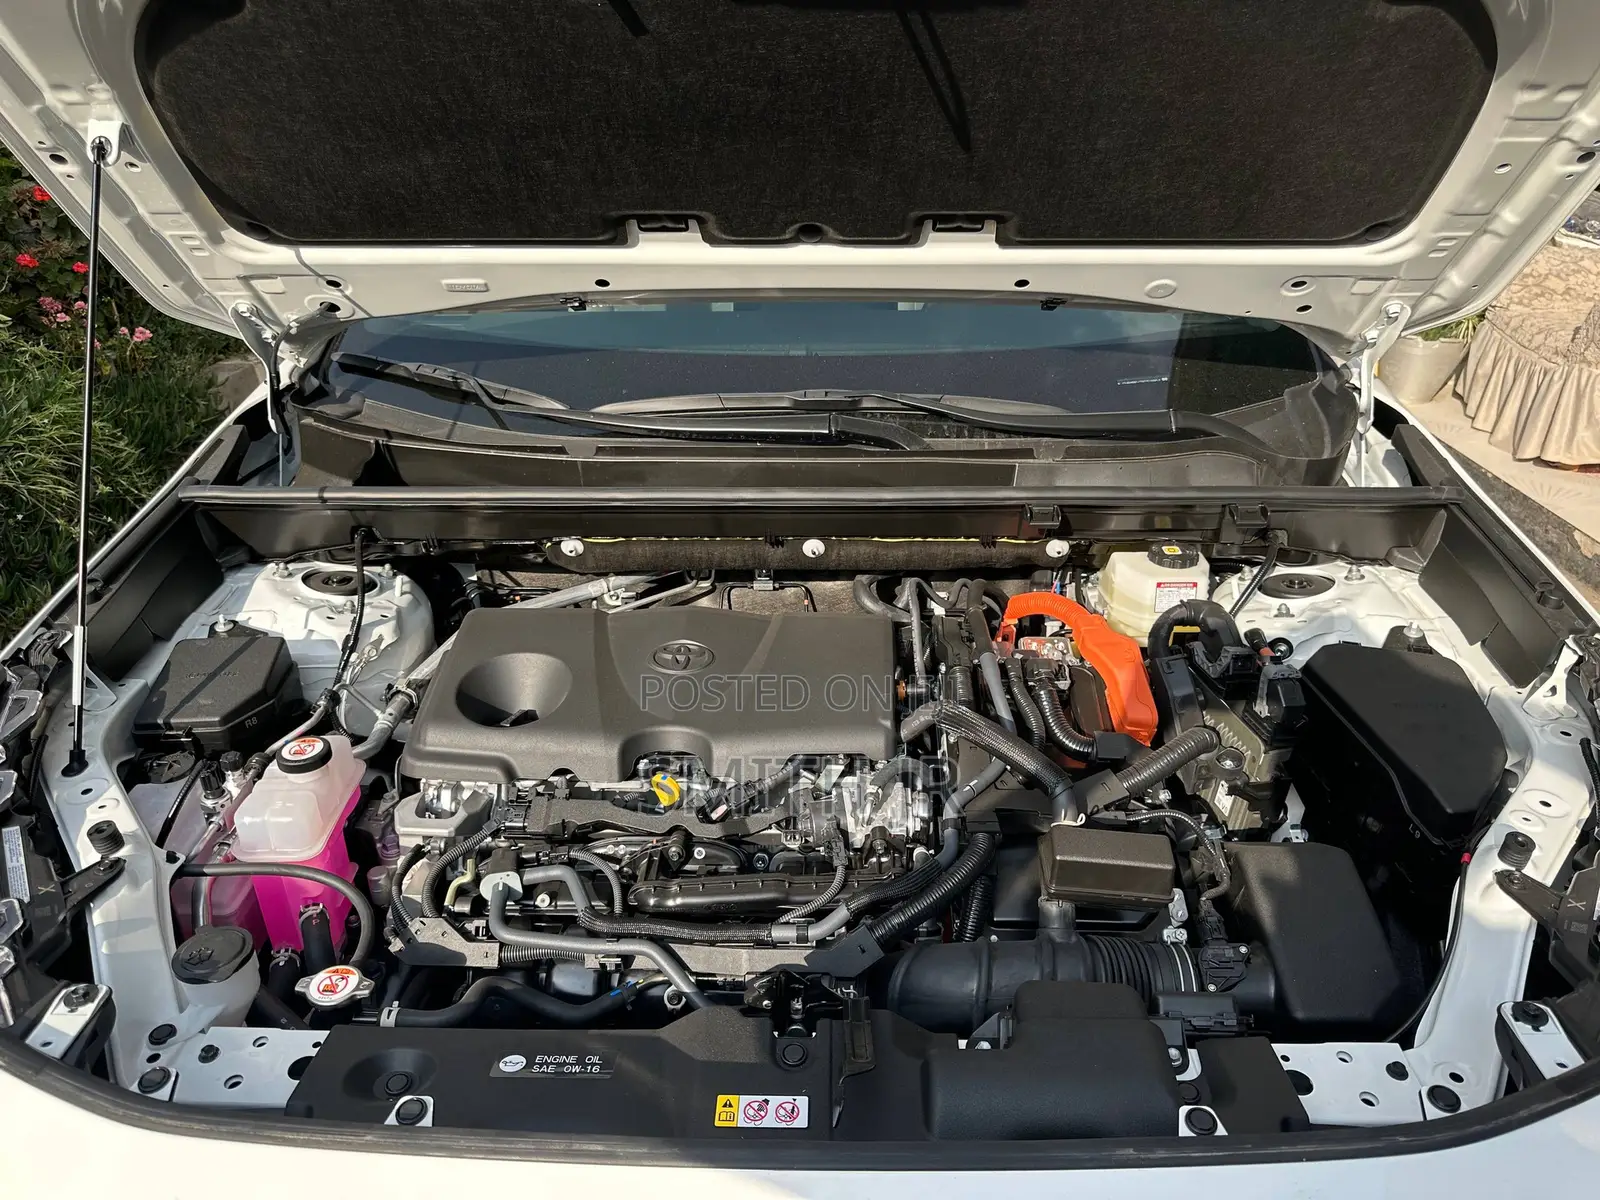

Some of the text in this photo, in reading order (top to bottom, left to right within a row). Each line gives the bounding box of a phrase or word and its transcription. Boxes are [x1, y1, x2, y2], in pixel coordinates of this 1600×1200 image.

[244, 716, 258, 728] R8
[535, 1055, 603, 1063] ENGINE OIL
[531, 1065, 600, 1073] SAE 0W-16
